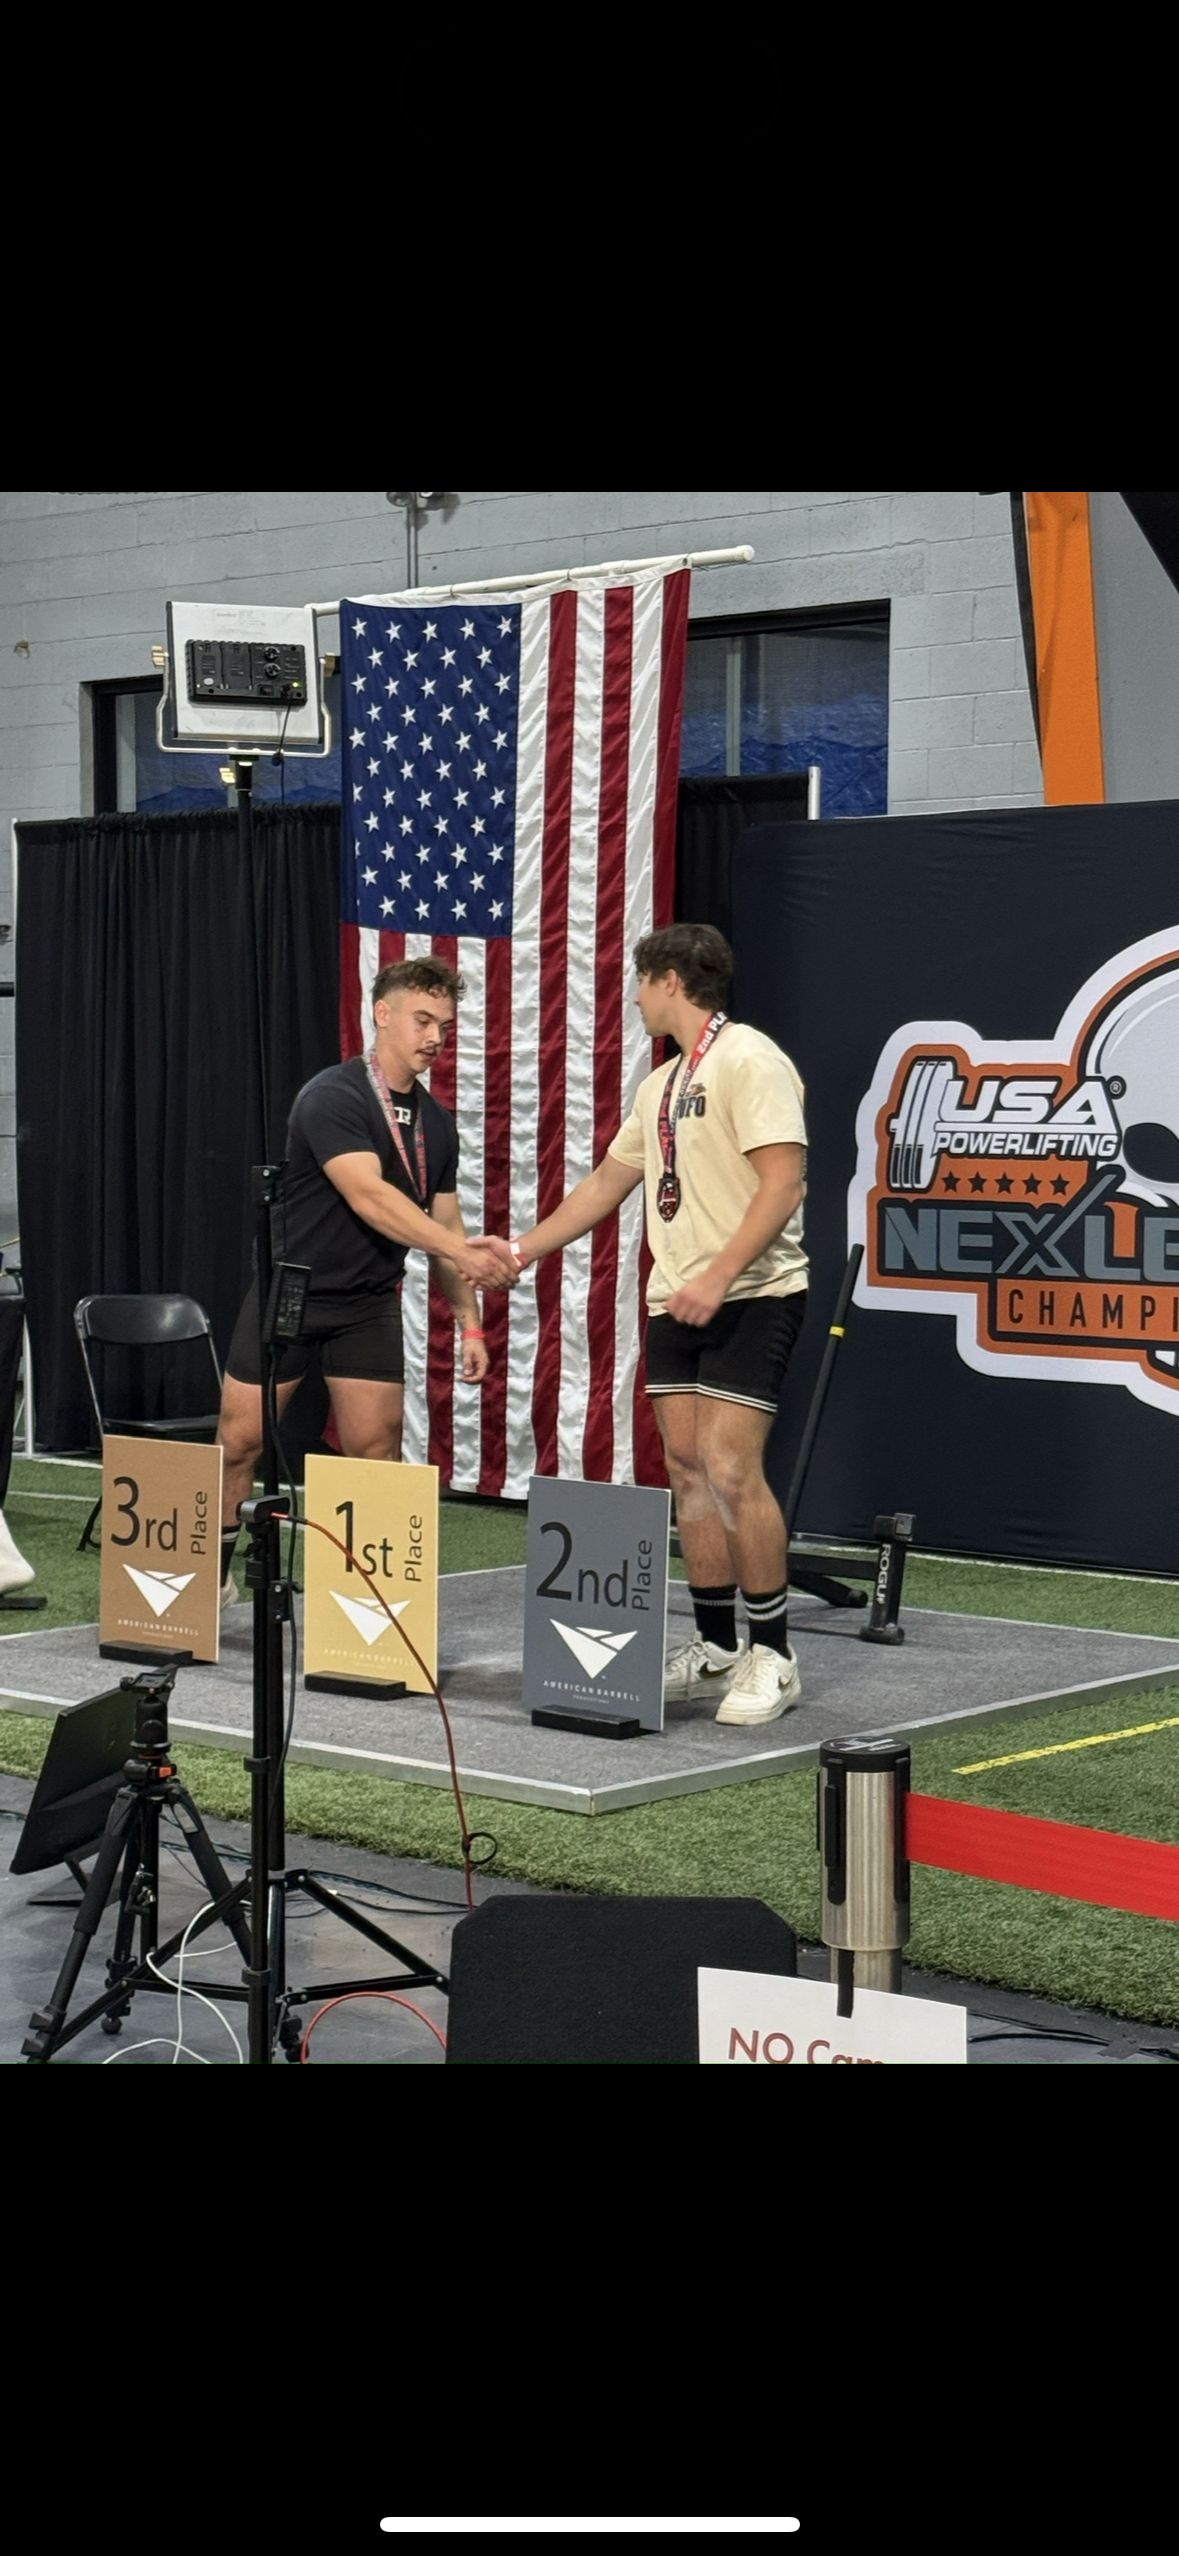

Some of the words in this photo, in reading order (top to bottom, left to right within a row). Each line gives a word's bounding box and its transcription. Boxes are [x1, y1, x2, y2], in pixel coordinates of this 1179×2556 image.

[938, 1080, 1118, 1134] USA
[931, 1132, 1119, 1158] POWERLIFTING
[1008, 1288, 1179, 1333] CHAMPI
[110, 1476, 178, 1551] 3rd
[190, 1490, 208, 1555] Place
[335, 1500, 393, 1578] 1st
[404, 1514, 423, 1583] Place
[535, 1521, 629, 1609] 2nd
[632, 1538, 653, 1611] Place
[543, 1680, 594, 1695] AMERICAN
[728, 2027, 795, 2064] NO
